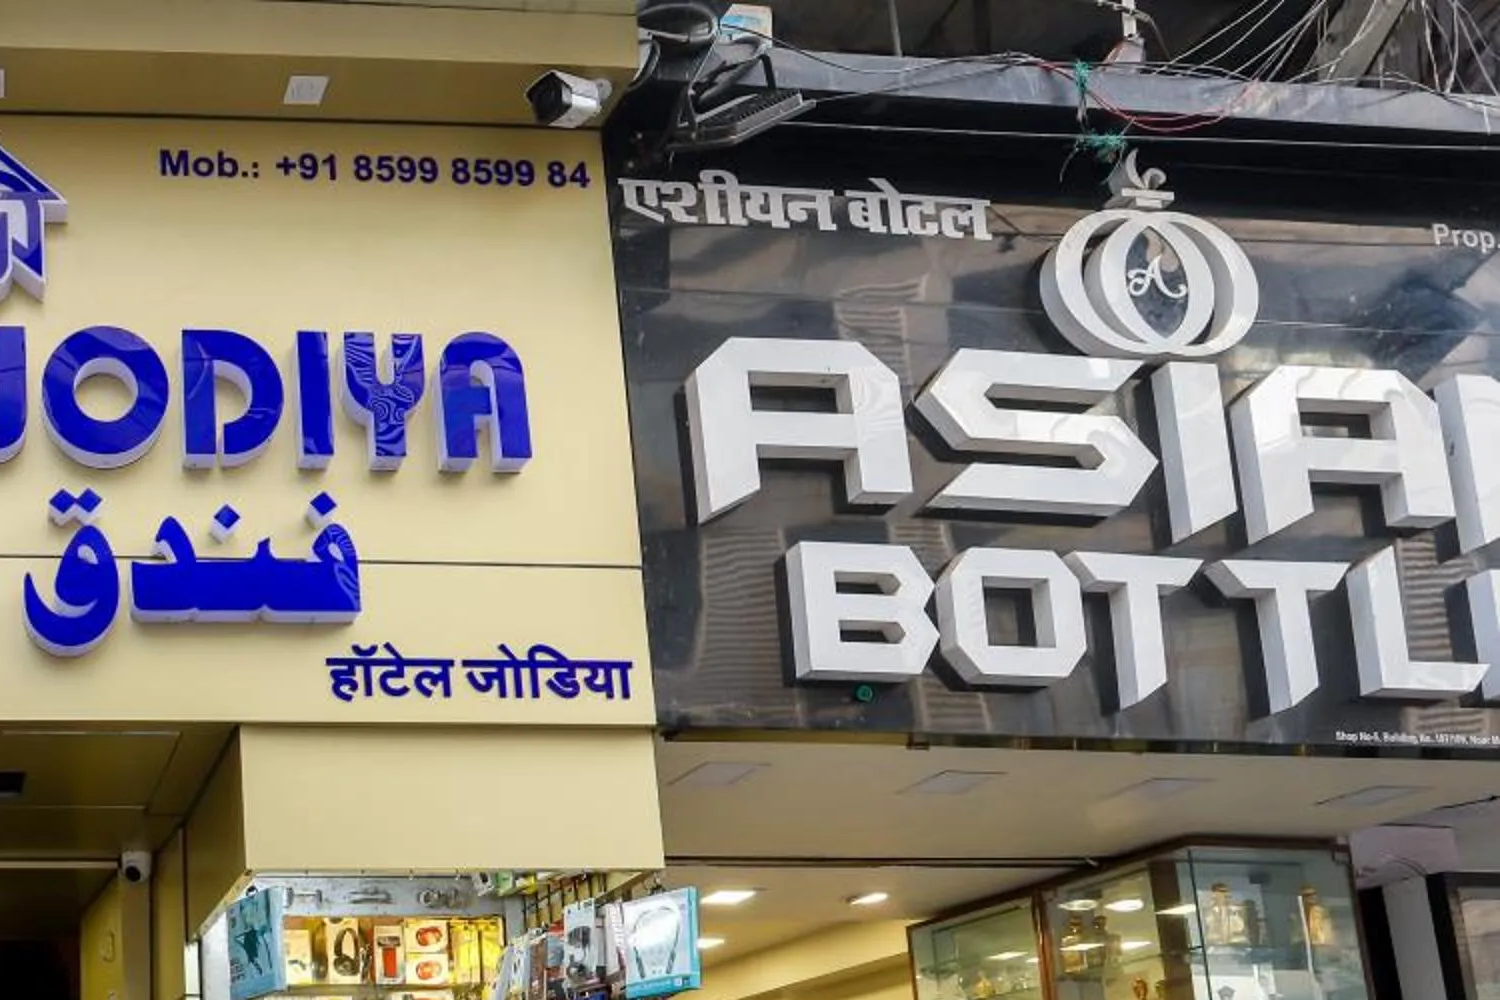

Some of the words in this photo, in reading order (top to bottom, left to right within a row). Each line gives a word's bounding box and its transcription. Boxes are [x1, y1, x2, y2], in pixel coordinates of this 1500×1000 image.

[159, 149, 260, 179] Mob.:
[276, 153, 338, 182] +91
[354, 155, 439, 184] 8599
[452, 158, 535, 187] 8599
[547, 161, 591, 189] 84
[617, 169, 837, 231] एशीयन
[844, 177, 993, 241] बोटल
[23, 488, 362, 658] فندق
[786, 540, 1500, 716] BOTTL
[325, 642, 455, 702] हॉटेल
[462, 644, 633, 700] जोडिया
